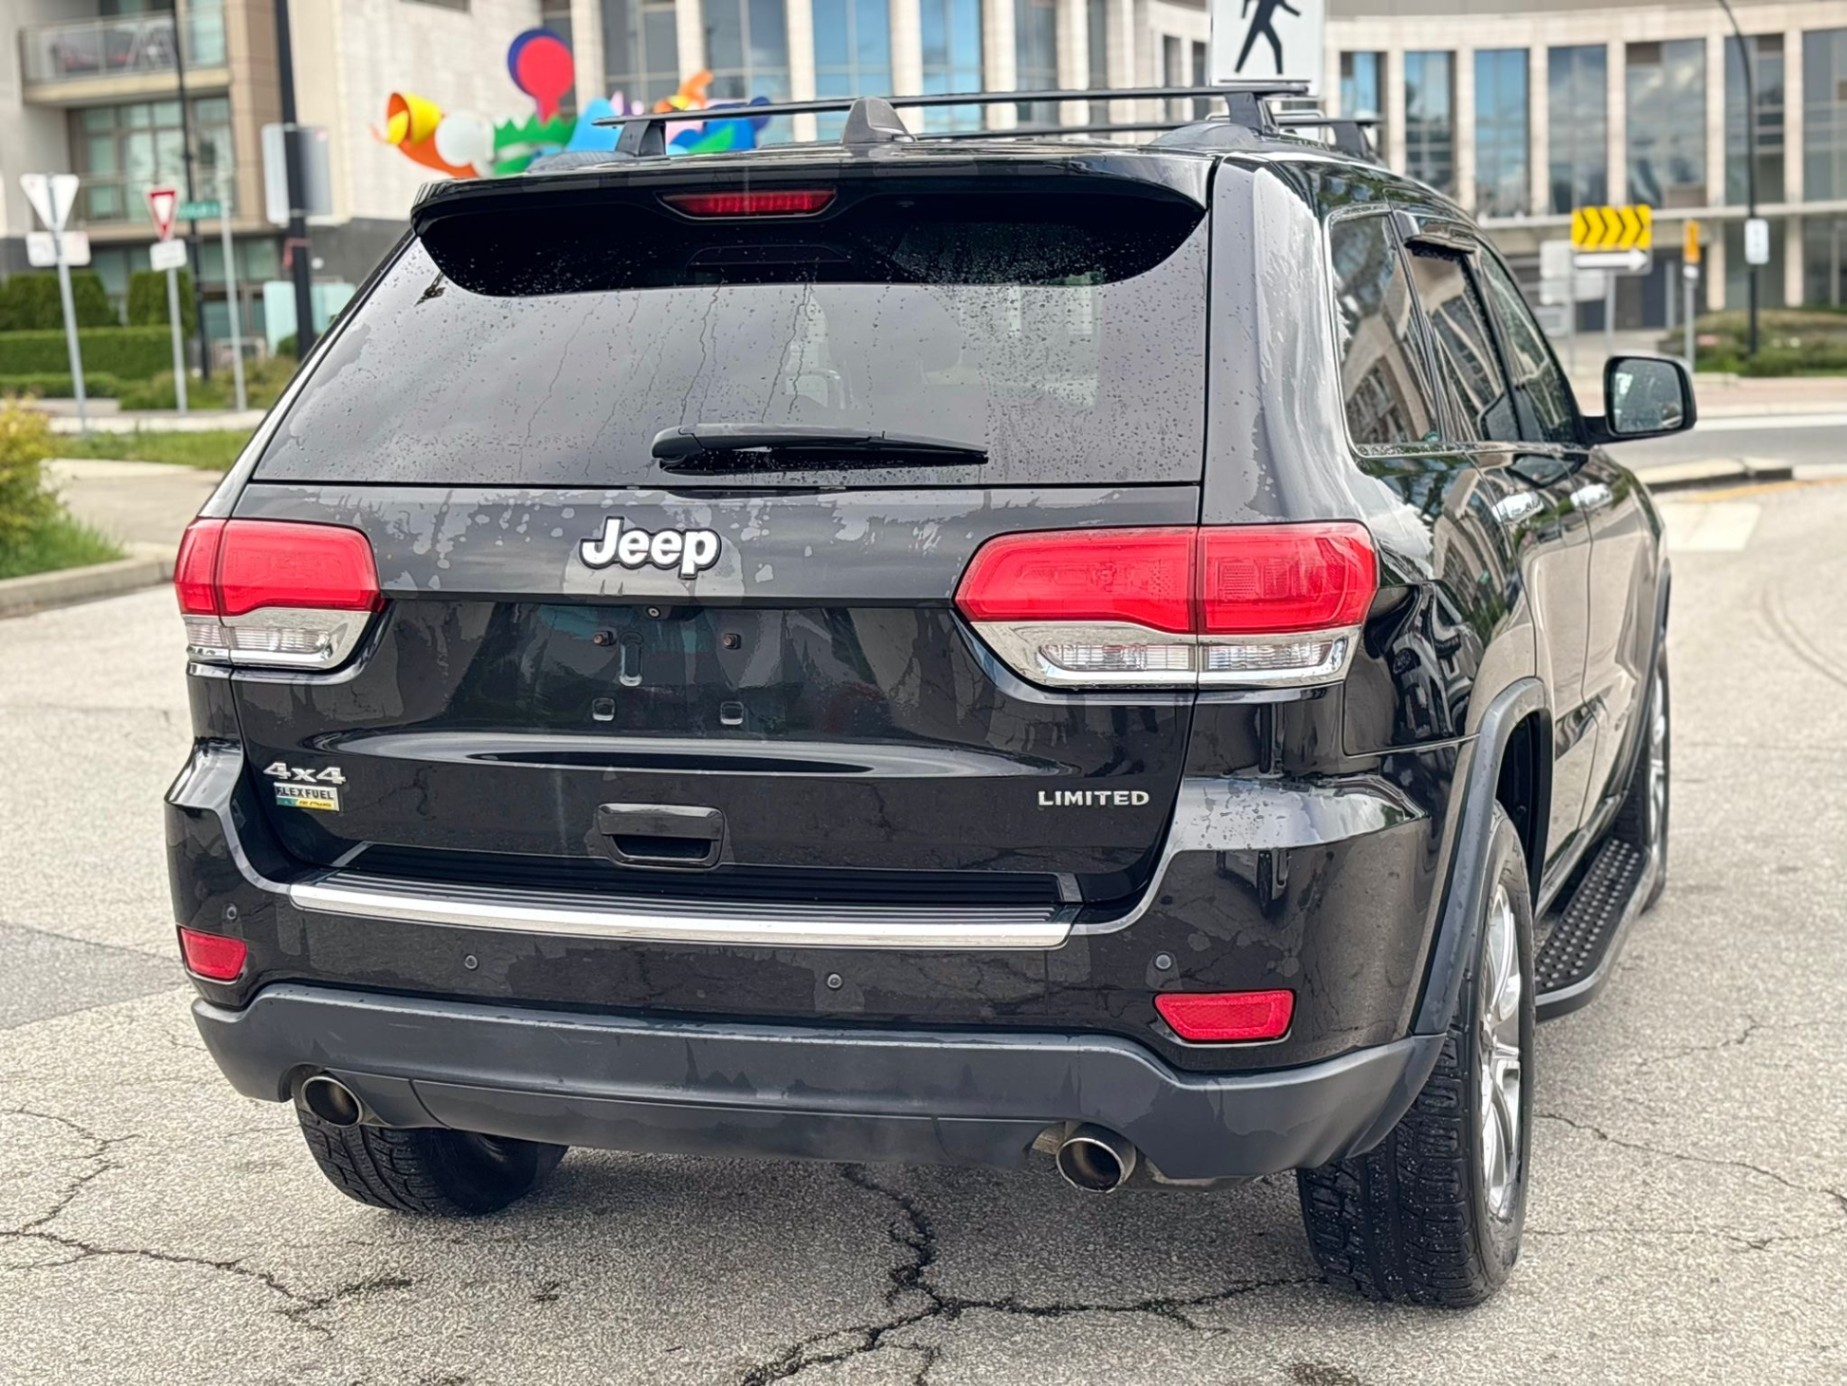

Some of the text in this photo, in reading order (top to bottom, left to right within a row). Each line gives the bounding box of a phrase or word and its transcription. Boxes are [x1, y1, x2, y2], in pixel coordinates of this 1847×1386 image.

[581, 517, 720, 578] Jeep
[263, 762, 346, 784] 4x4
[1038, 790, 1150, 806] LIMITED
